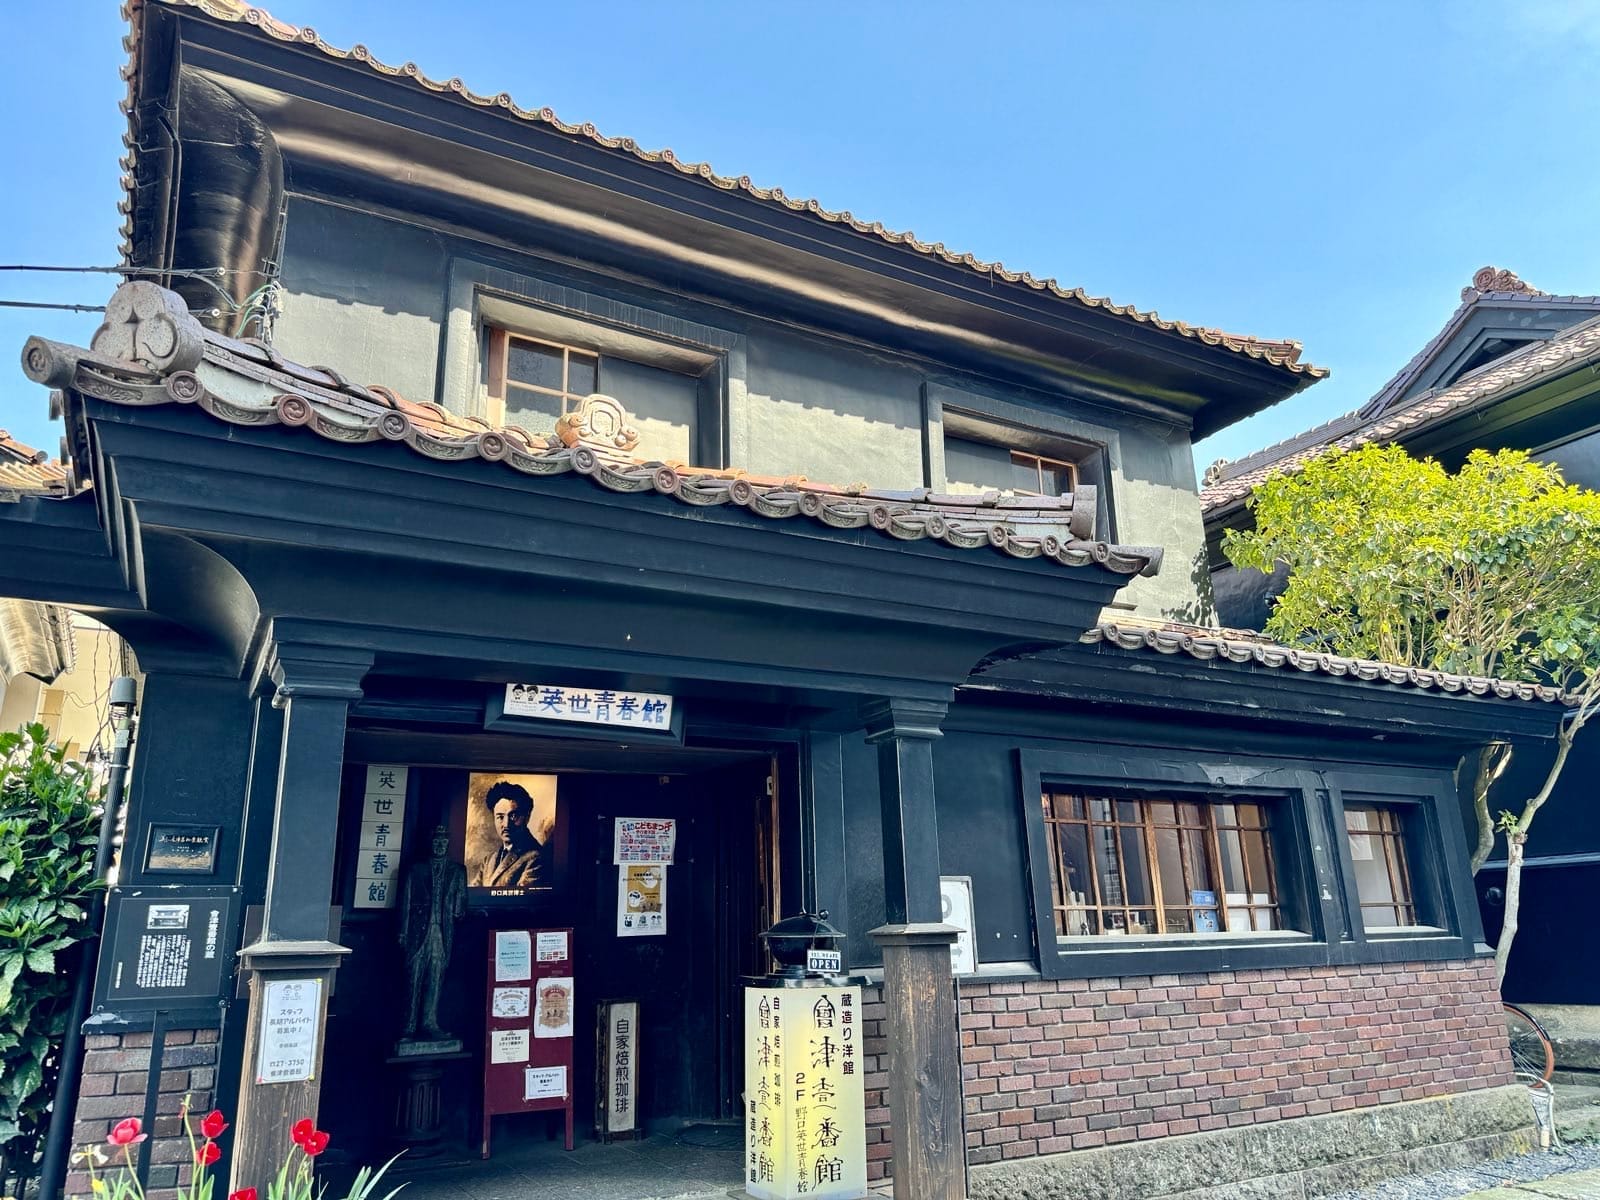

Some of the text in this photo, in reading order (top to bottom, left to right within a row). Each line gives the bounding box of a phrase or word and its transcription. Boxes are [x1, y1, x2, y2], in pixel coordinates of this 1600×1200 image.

[538, 687, 668, 725] 英世青春館
[368, 770, 396, 902] 英世青春館
[811, 959, 837, 969] OPEN
[280, 1008, 303, 1016] スタッフ
[841, 993, 854, 1075] 蔵造り洋館
[615, 1018, 630, 1113] 自家焙煎珈琲
[796, 1072, 806, 1101] 2F
[795, 1106, 808, 1193] 野口英世青春館
